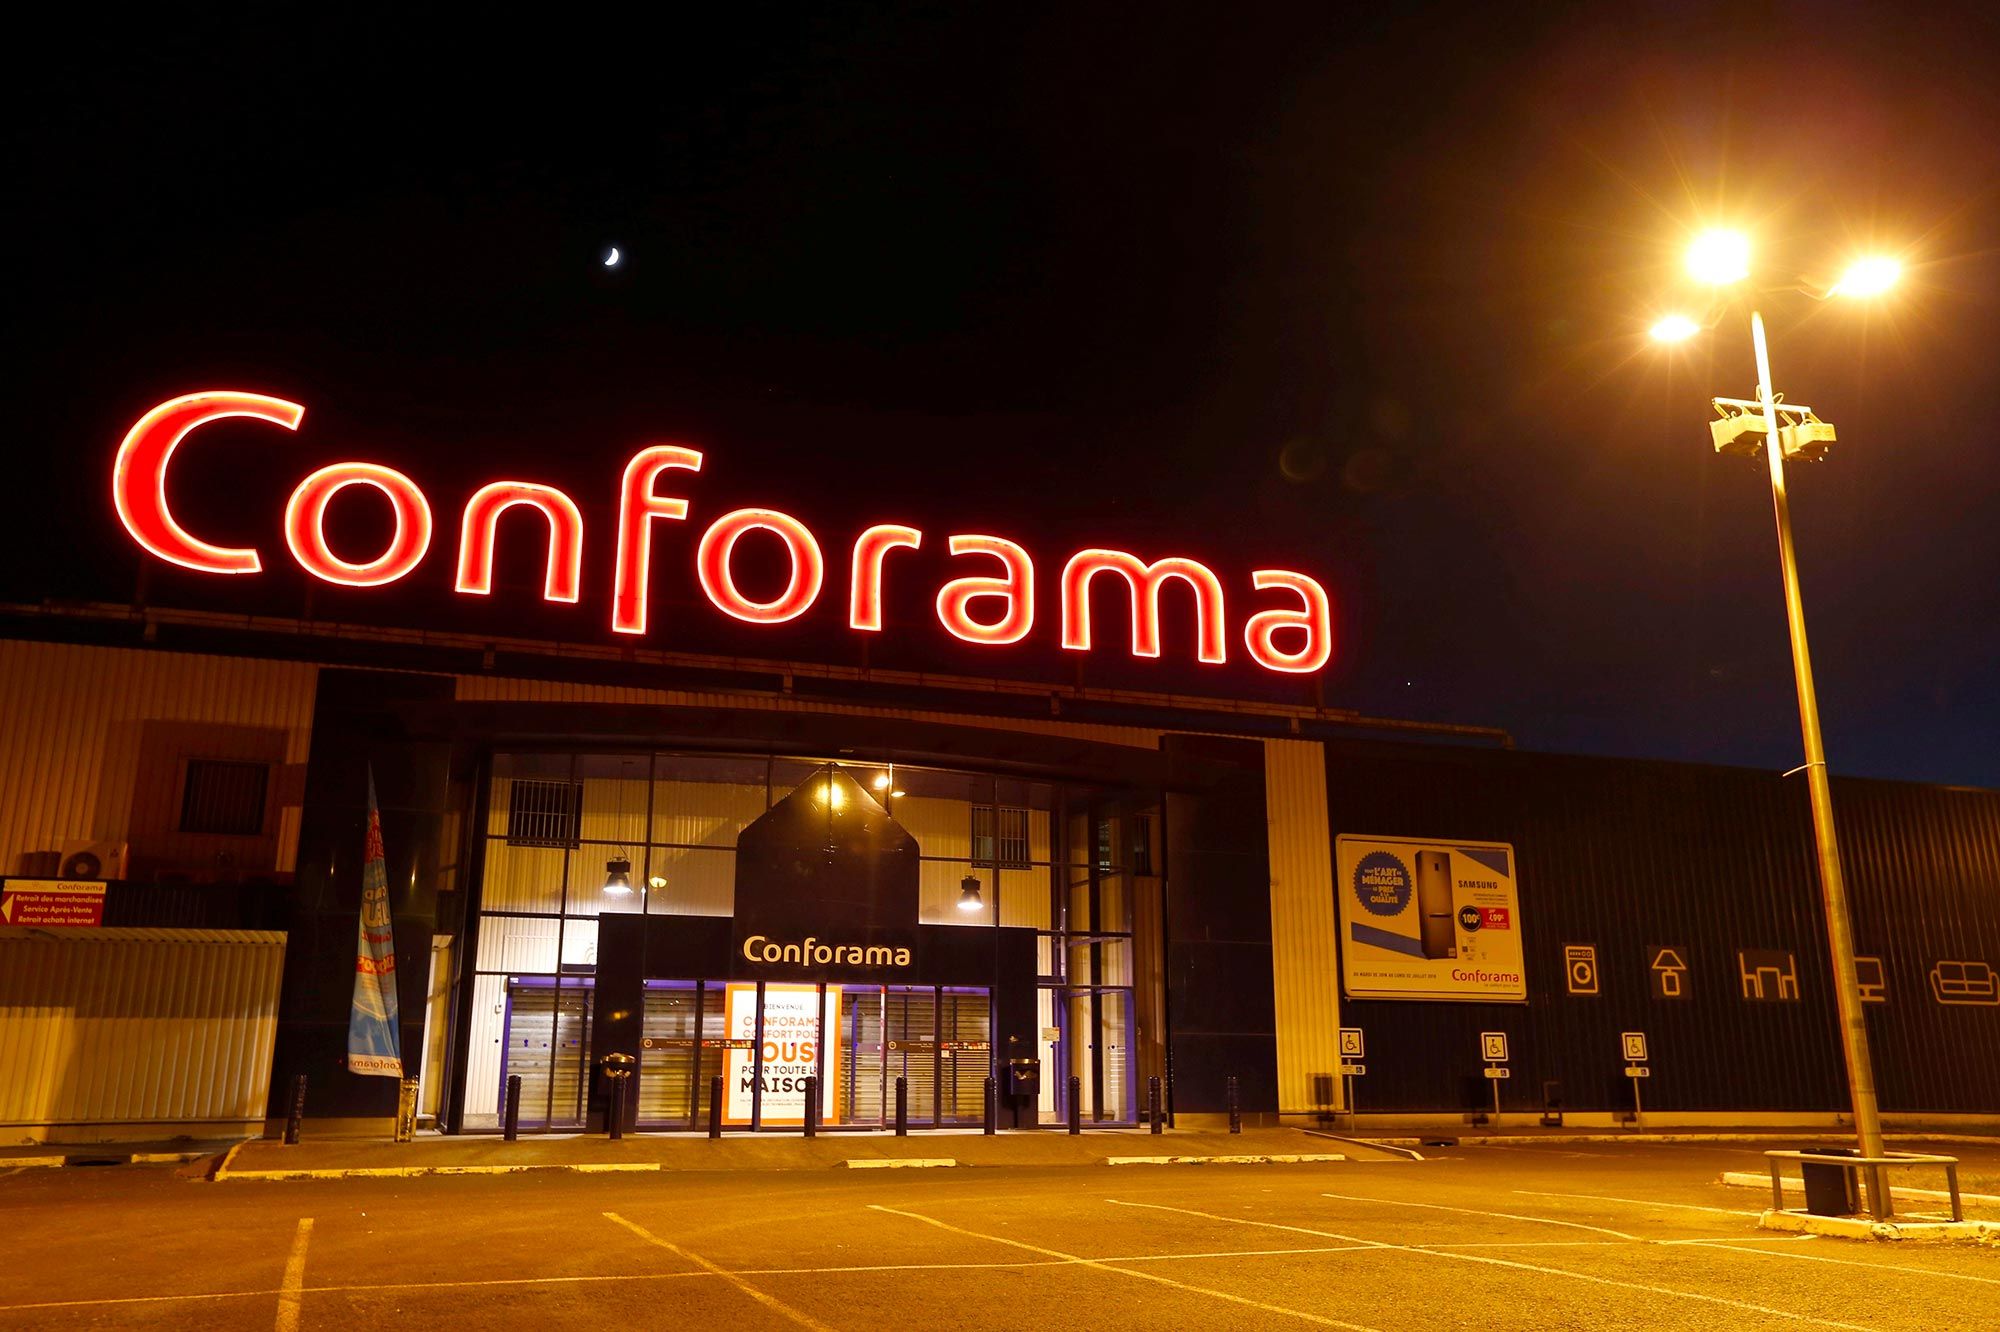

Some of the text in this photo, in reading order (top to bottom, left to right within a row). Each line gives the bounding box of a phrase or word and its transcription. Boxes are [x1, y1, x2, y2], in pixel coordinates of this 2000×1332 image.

[112, 390, 1333, 674] Conforama
[57, 883, 104, 892] Conforama
[1458, 880, 1498, 889] SAMSUNG
[16, 894, 40, 902] Retrait
[55, 895, 103, 904] marchandises
[23, 905, 93, 914] Service Après-Vente
[18, 915, 95, 924] Retrait achats internet
[743, 935, 911, 967] Conforama
[1452, 969, 1519, 982] Conforama
[764, 1003, 803, 1011] BIENVENUE
[743, 1016, 817, 1026] CNFORAM
[796, 1030, 817, 1039] POU
[742, 1066, 770, 1074] POR
[773, 1066, 807, 1074] TOUTE
[741, 1077, 808, 1093] MAISO
